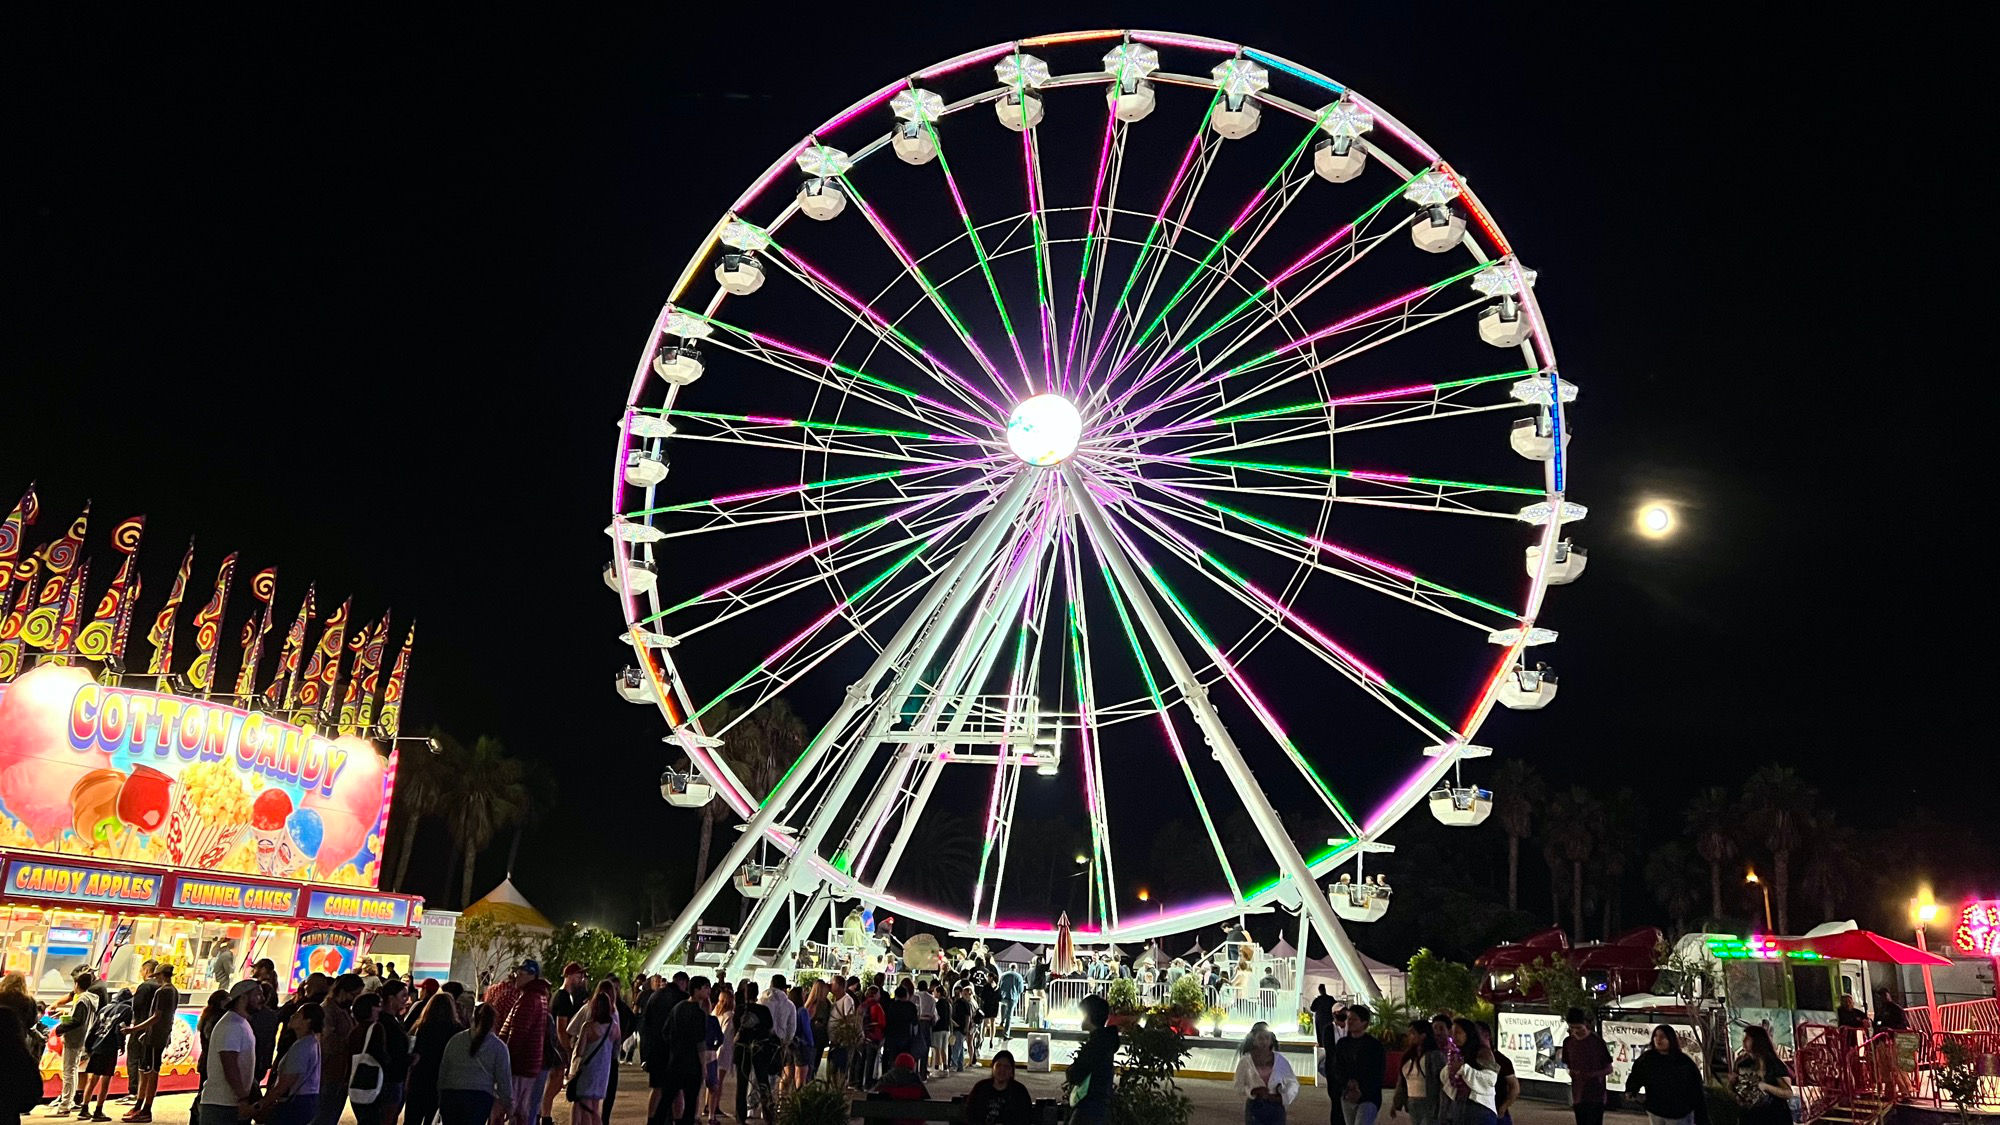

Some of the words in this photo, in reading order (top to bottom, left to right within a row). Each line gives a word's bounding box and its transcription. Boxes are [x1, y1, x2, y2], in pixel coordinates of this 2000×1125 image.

[68, 683, 233, 762] COTTON
[237, 711, 348, 797] CANDY
[15, 866, 86, 893] CANDY
[84, 873, 154, 900] APPLES
[180, 882, 241, 908] FUNNEL
[243, 888, 292, 911] CAKES
[324, 896, 360, 917] CORN
[361, 900, 395, 920] DOGS
[302, 933, 327, 947] CANDY
[328, 933, 355, 950] APPLES
[1505, 1018, 1532, 1026] VENTURA
[1534, 1020, 1561, 1028] COUNTY
[1610, 1025, 1649, 1036] VENTURA
[1500, 1032, 1535, 1052] FAIR
